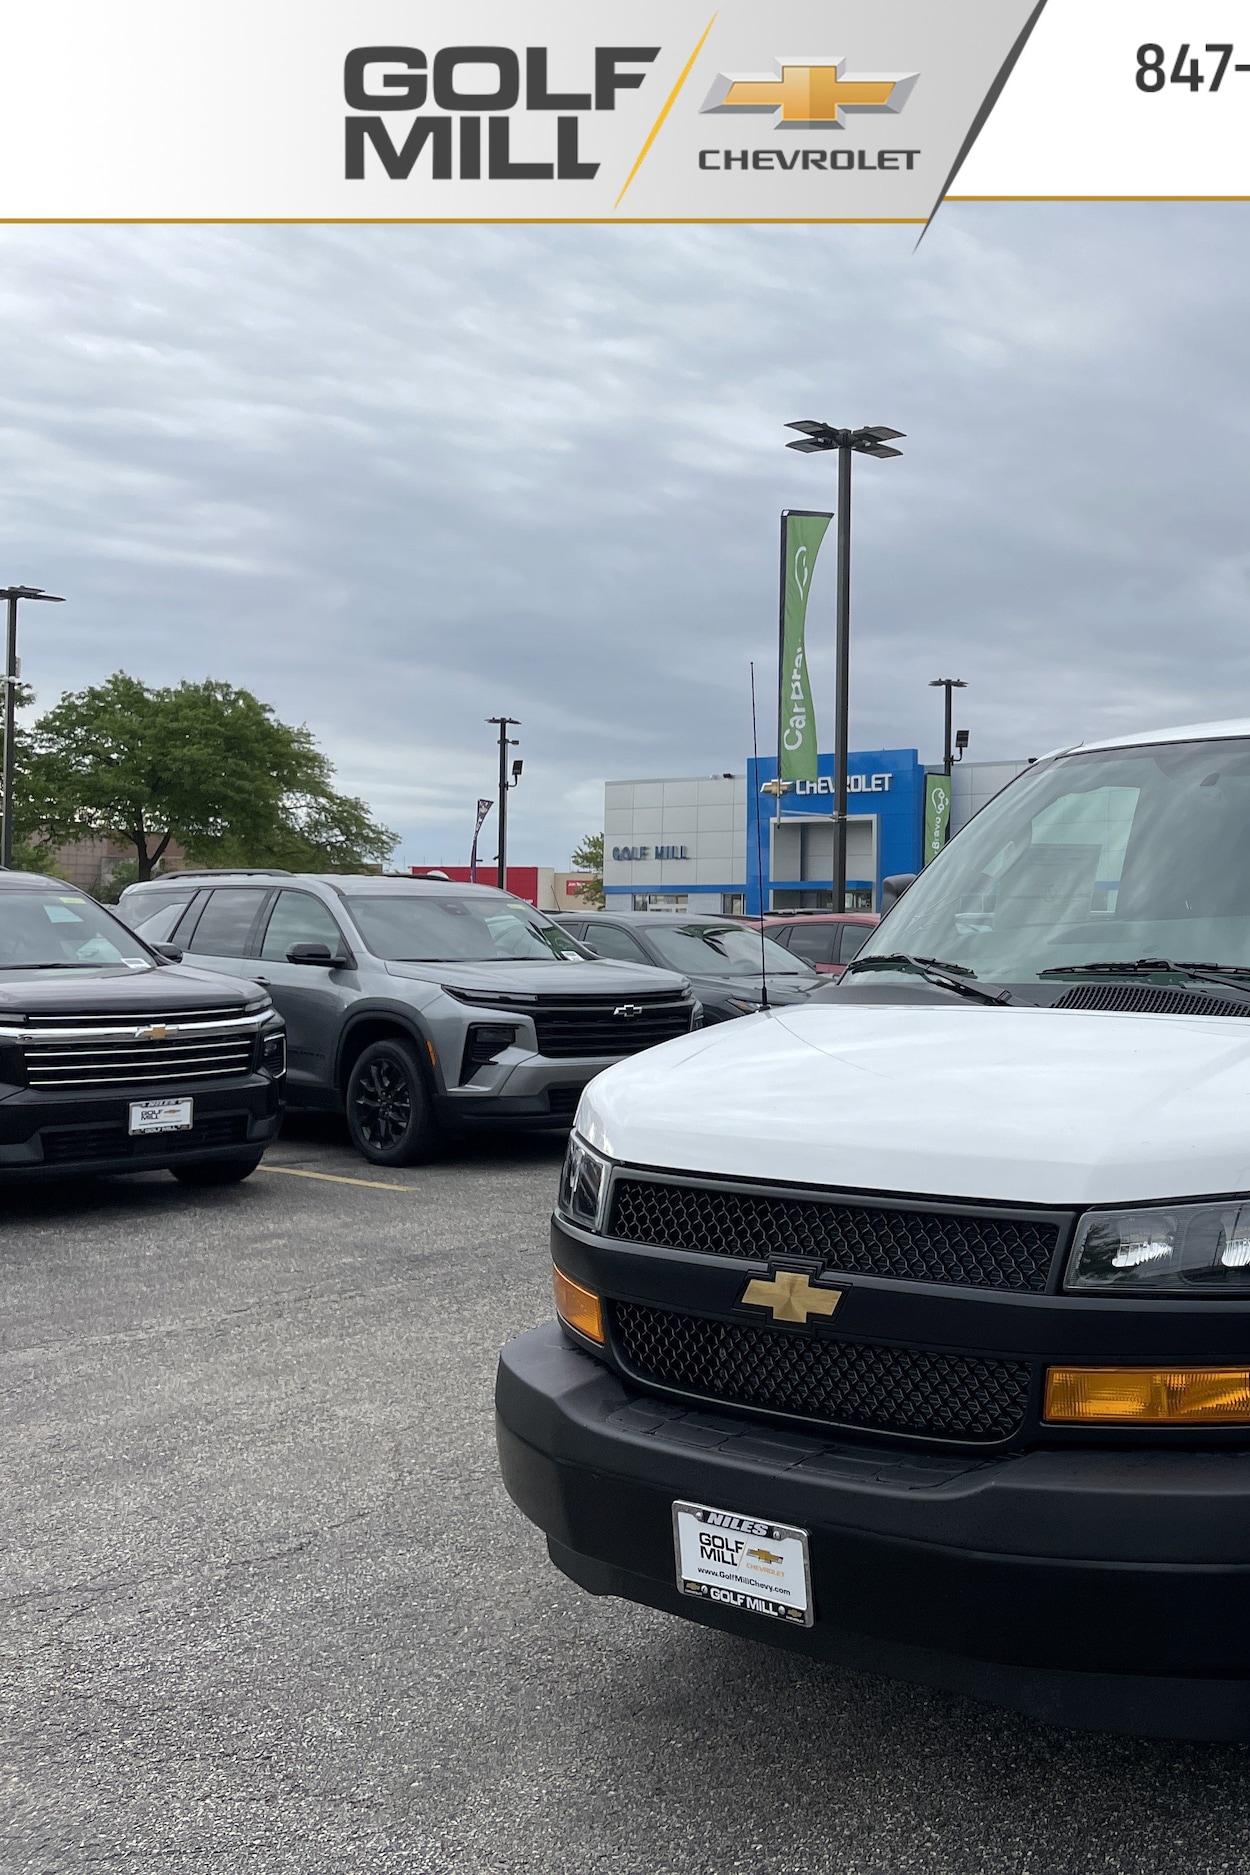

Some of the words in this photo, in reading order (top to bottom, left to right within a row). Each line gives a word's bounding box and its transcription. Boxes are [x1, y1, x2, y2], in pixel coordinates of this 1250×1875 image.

[795, 773, 893, 796] CHEVOLET
[612, 845, 650, 861] GOLF
[654, 845, 690, 860] MILL
[707, 1512, 769, 1536] NILES
[699, 1532, 745, 1554] GOLF
[700, 1546, 738, 1567] MILL
[746, 1562, 785, 1577] CHEVROLET
[697, 1566, 791, 1597] www.GolfMillChevy.com
[710, 1588, 745, 1607] GOLF
[746, 1598, 779, 1617] MILL
